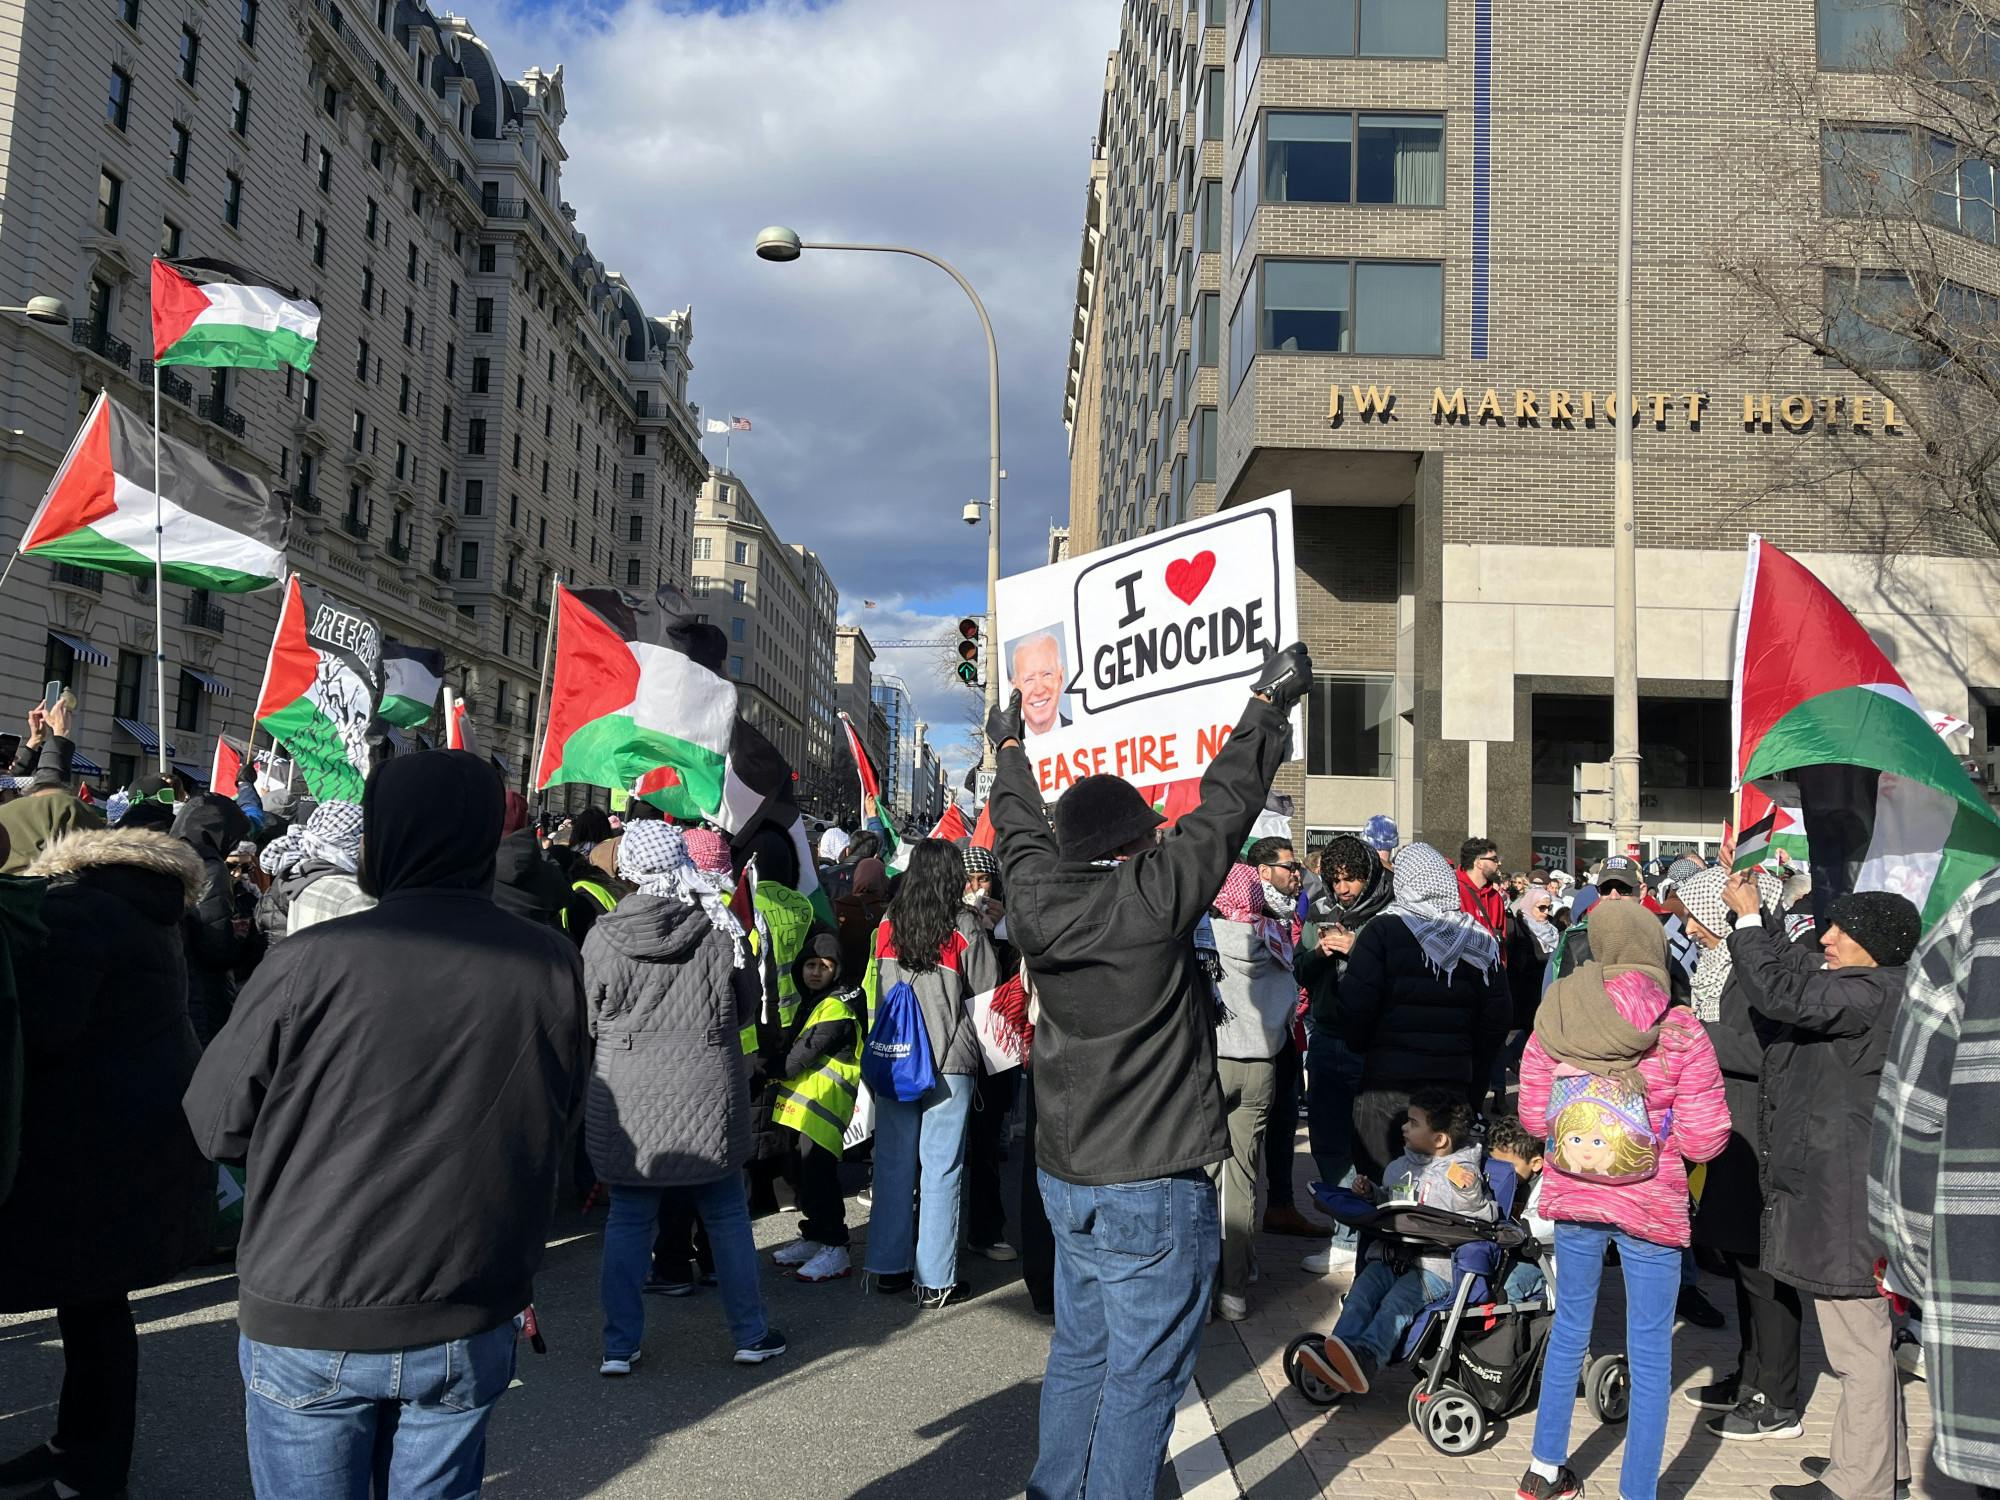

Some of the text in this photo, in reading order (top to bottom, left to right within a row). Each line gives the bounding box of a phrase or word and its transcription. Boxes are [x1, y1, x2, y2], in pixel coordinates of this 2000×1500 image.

[1430, 386, 1709, 423] MARRIOTT
[1743, 393, 1904, 427] HOTEL
[1115, 569, 1146, 629] I
[310, 603, 360, 651] FREE
[1093, 597, 1264, 691] GENOCIDE
[980, 774, 994, 784] ON
[1037, 724, 1233, 793] EASE FIRE NO
[979, 785, 992, 794] WA
[843, 1122, 865, 1146] OW
